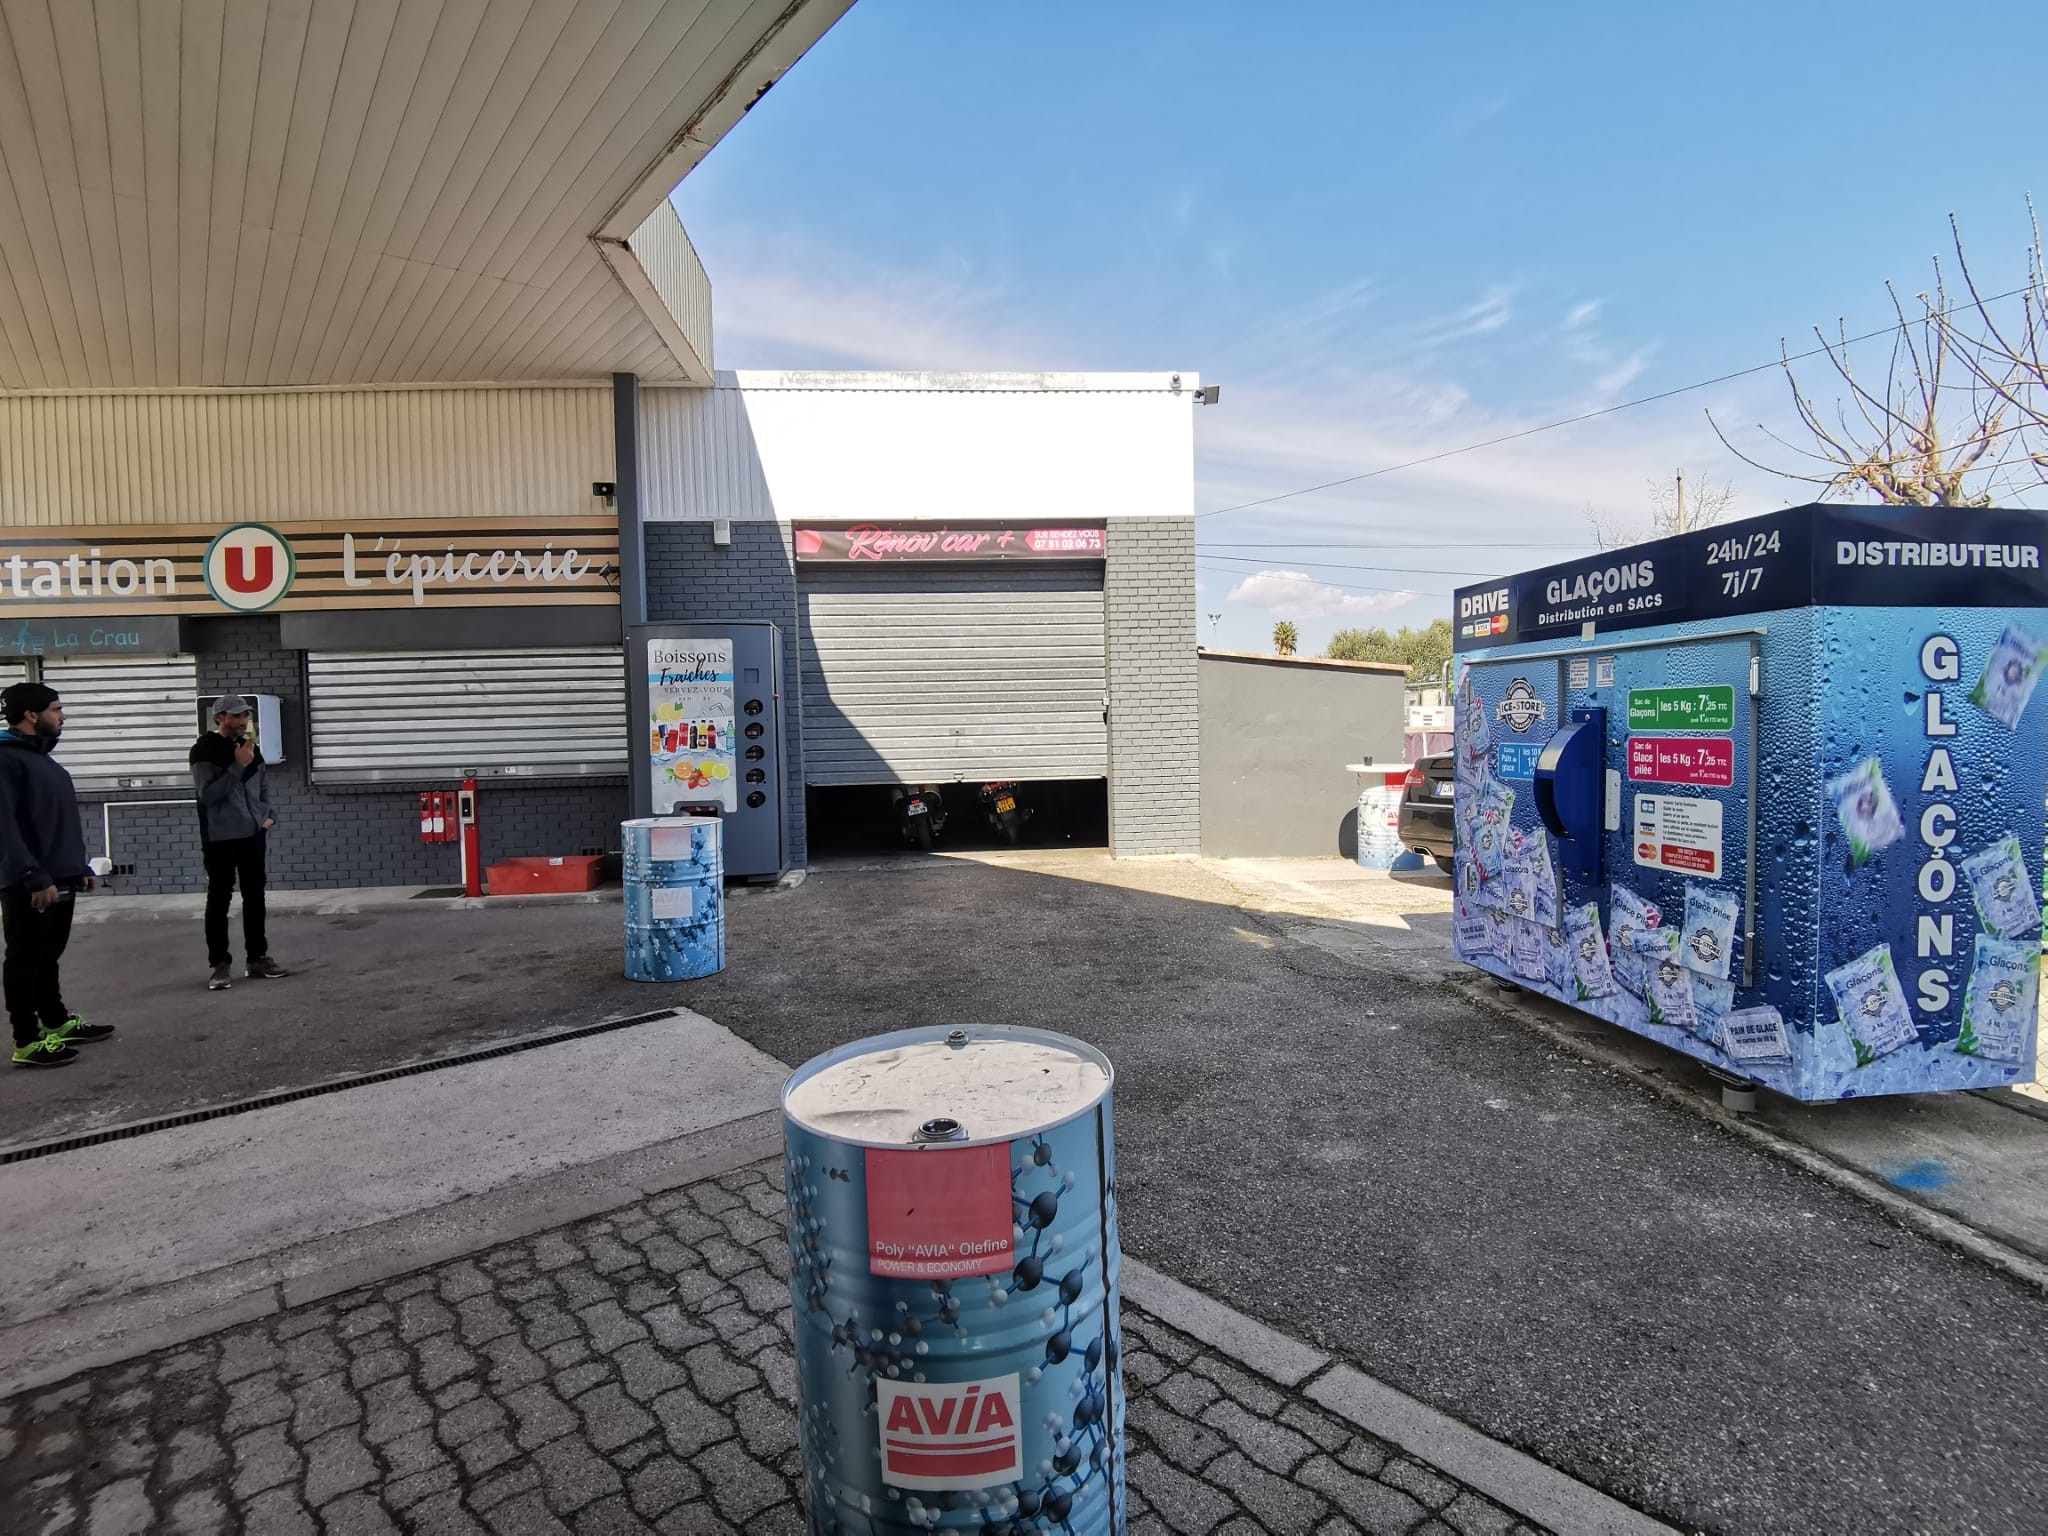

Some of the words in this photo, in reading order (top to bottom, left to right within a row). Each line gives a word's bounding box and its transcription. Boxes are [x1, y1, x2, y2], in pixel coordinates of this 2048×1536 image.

[1079, 530, 1100, 538] VOUS
[1034, 539, 1046, 549] 07
[1062, 539, 1074, 549] 02
[1075, 539, 1088, 549] 06
[1089, 539, 1101, 549] 73
[1706, 530, 1781, 566] 24h/24
[1836, 541, 2040, 569] DISTRIBUTEUR
[0, 548, 176, 598] tation
[225, 546, 273, 593] U
[343, 533, 591, 605] L'épicerie
[1546, 560, 1655, 603] GLAÇONS
[1721, 567, 1763, 598] 7j/7
[1460, 588, 1510, 618] DRIVE
[1538, 605, 1604, 625] Distribution
[1608, 602, 1623, 614] en
[1628, 593, 1663, 611] SACS
[54, 628, 80, 648] La
[89, 629, 139, 646] Crau
[654, 649, 727, 664] Boissons
[1501, 700, 1541, 714] ICE-STORE
[1629, 707, 1656, 719] Glaçons
[1660, 701, 1672, 712] les
[1673, 701, 1679, 711] 5
[1680, 700, 1692, 713] Kg
[1634, 742, 1644, 750] Sac
[1645, 742, 1652, 750] de
[1633, 751, 1654, 763] Glace
[1660, 753, 1672, 763] les
[1673, 753, 1679, 764] 5
[1680, 753, 1691, 767] Kg
[1634, 764, 1653, 776] pilée
[1917, 635, 1960, 1013] GLAÇONS
[1980, 855, 2013, 876] Glaçons
[1689, 897, 1711, 914] Glace
[1642, 944, 1672, 953] Glaçons
[1989, 955, 2030, 973] Glaçons
[1846, 967, 1884, 989] Glaçons
[1756, 1022, 1779, 1034] GLACE
[875, 1241, 904, 1259] Poly
[959, 1239, 1008, 1255] Olefine
[877, 1258, 915, 1273] POWER
[917, 1261, 924, 1273] &
[926, 1258, 983, 1273] ECONOMY
